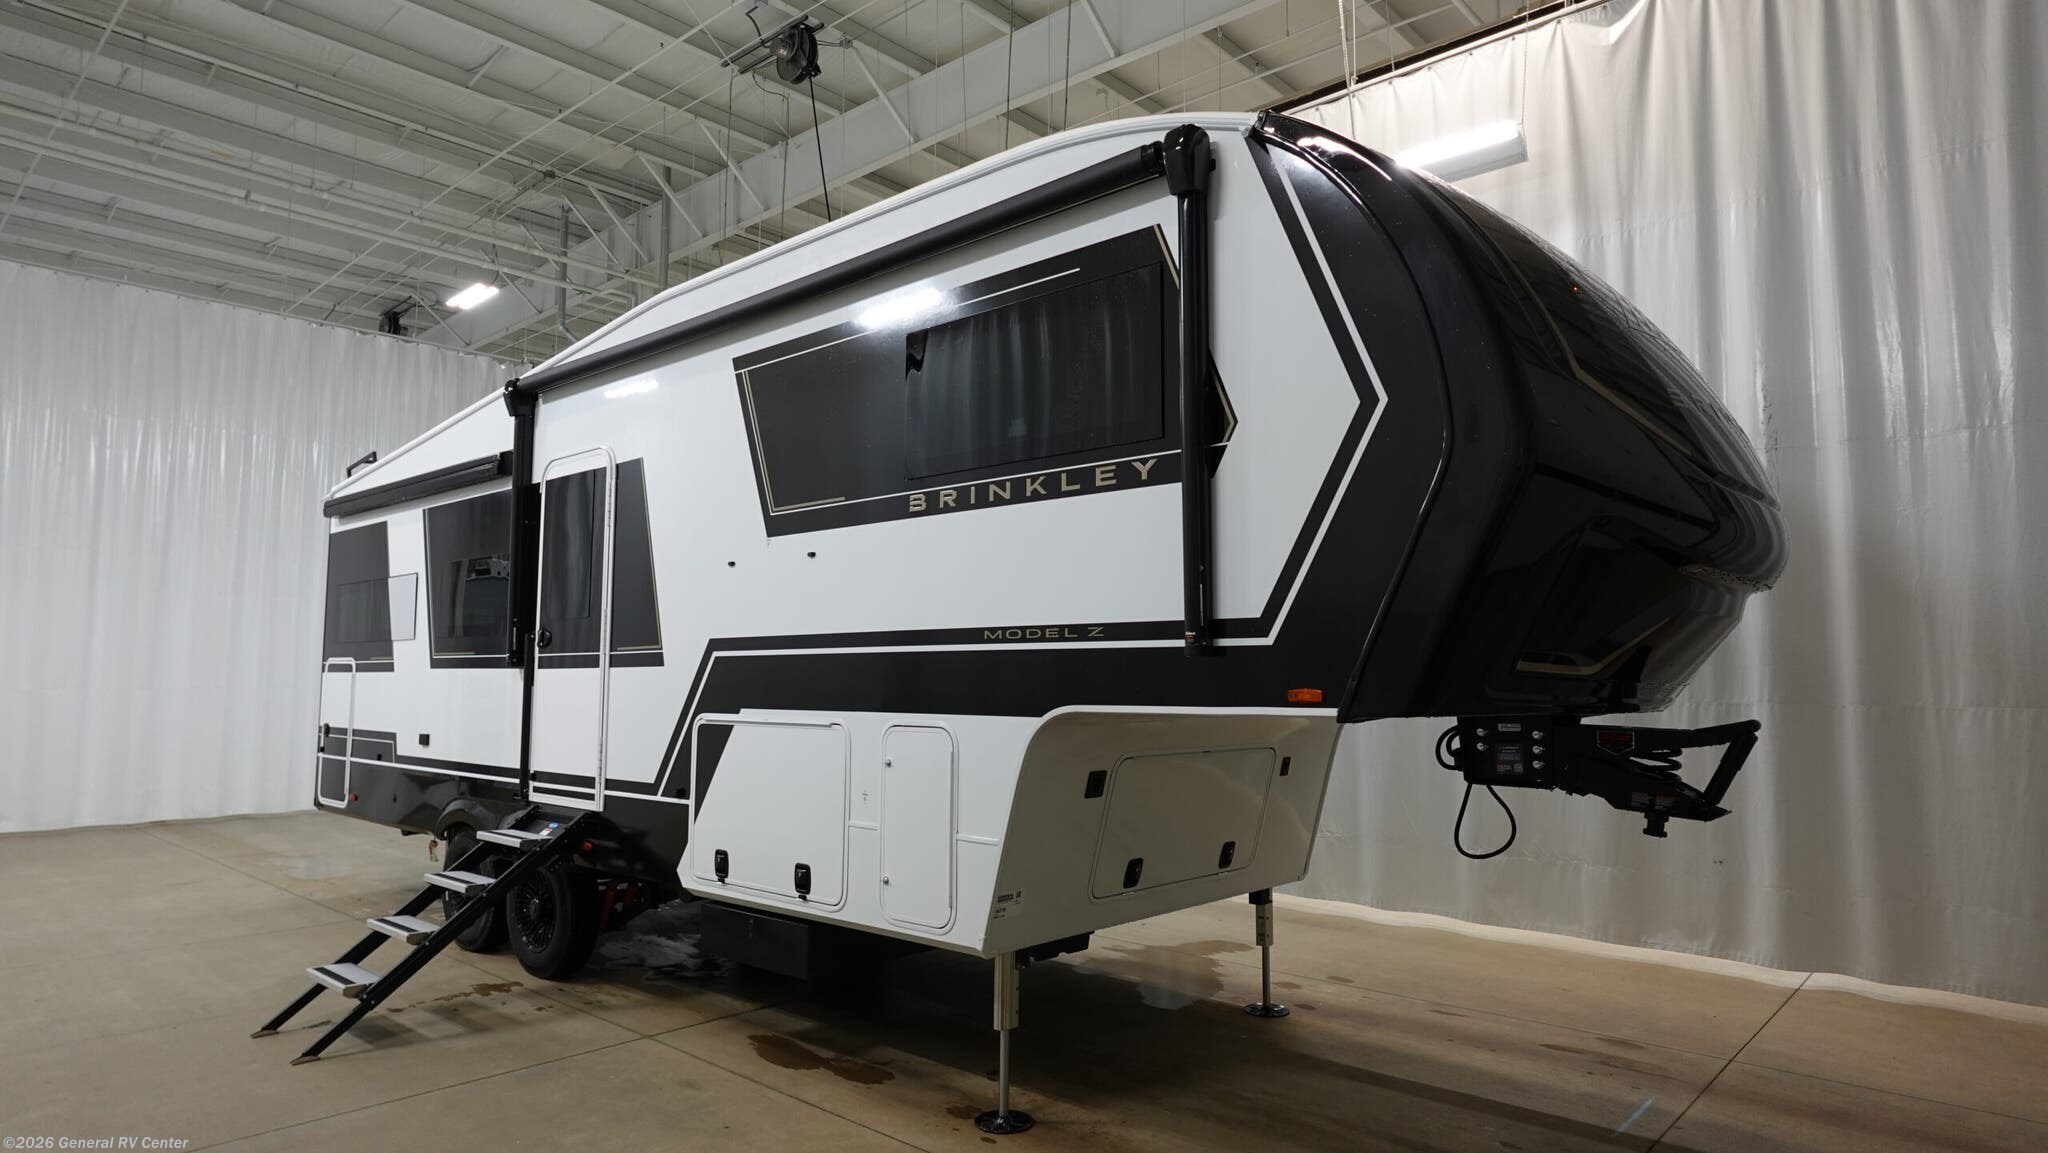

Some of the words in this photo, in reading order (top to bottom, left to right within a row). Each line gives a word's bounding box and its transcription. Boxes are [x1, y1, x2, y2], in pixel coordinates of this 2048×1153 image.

[909, 458, 1158, 512] BRINKLEY
[984, 628, 1078, 640] MODEL
[1087, 627, 1104, 637] Z
